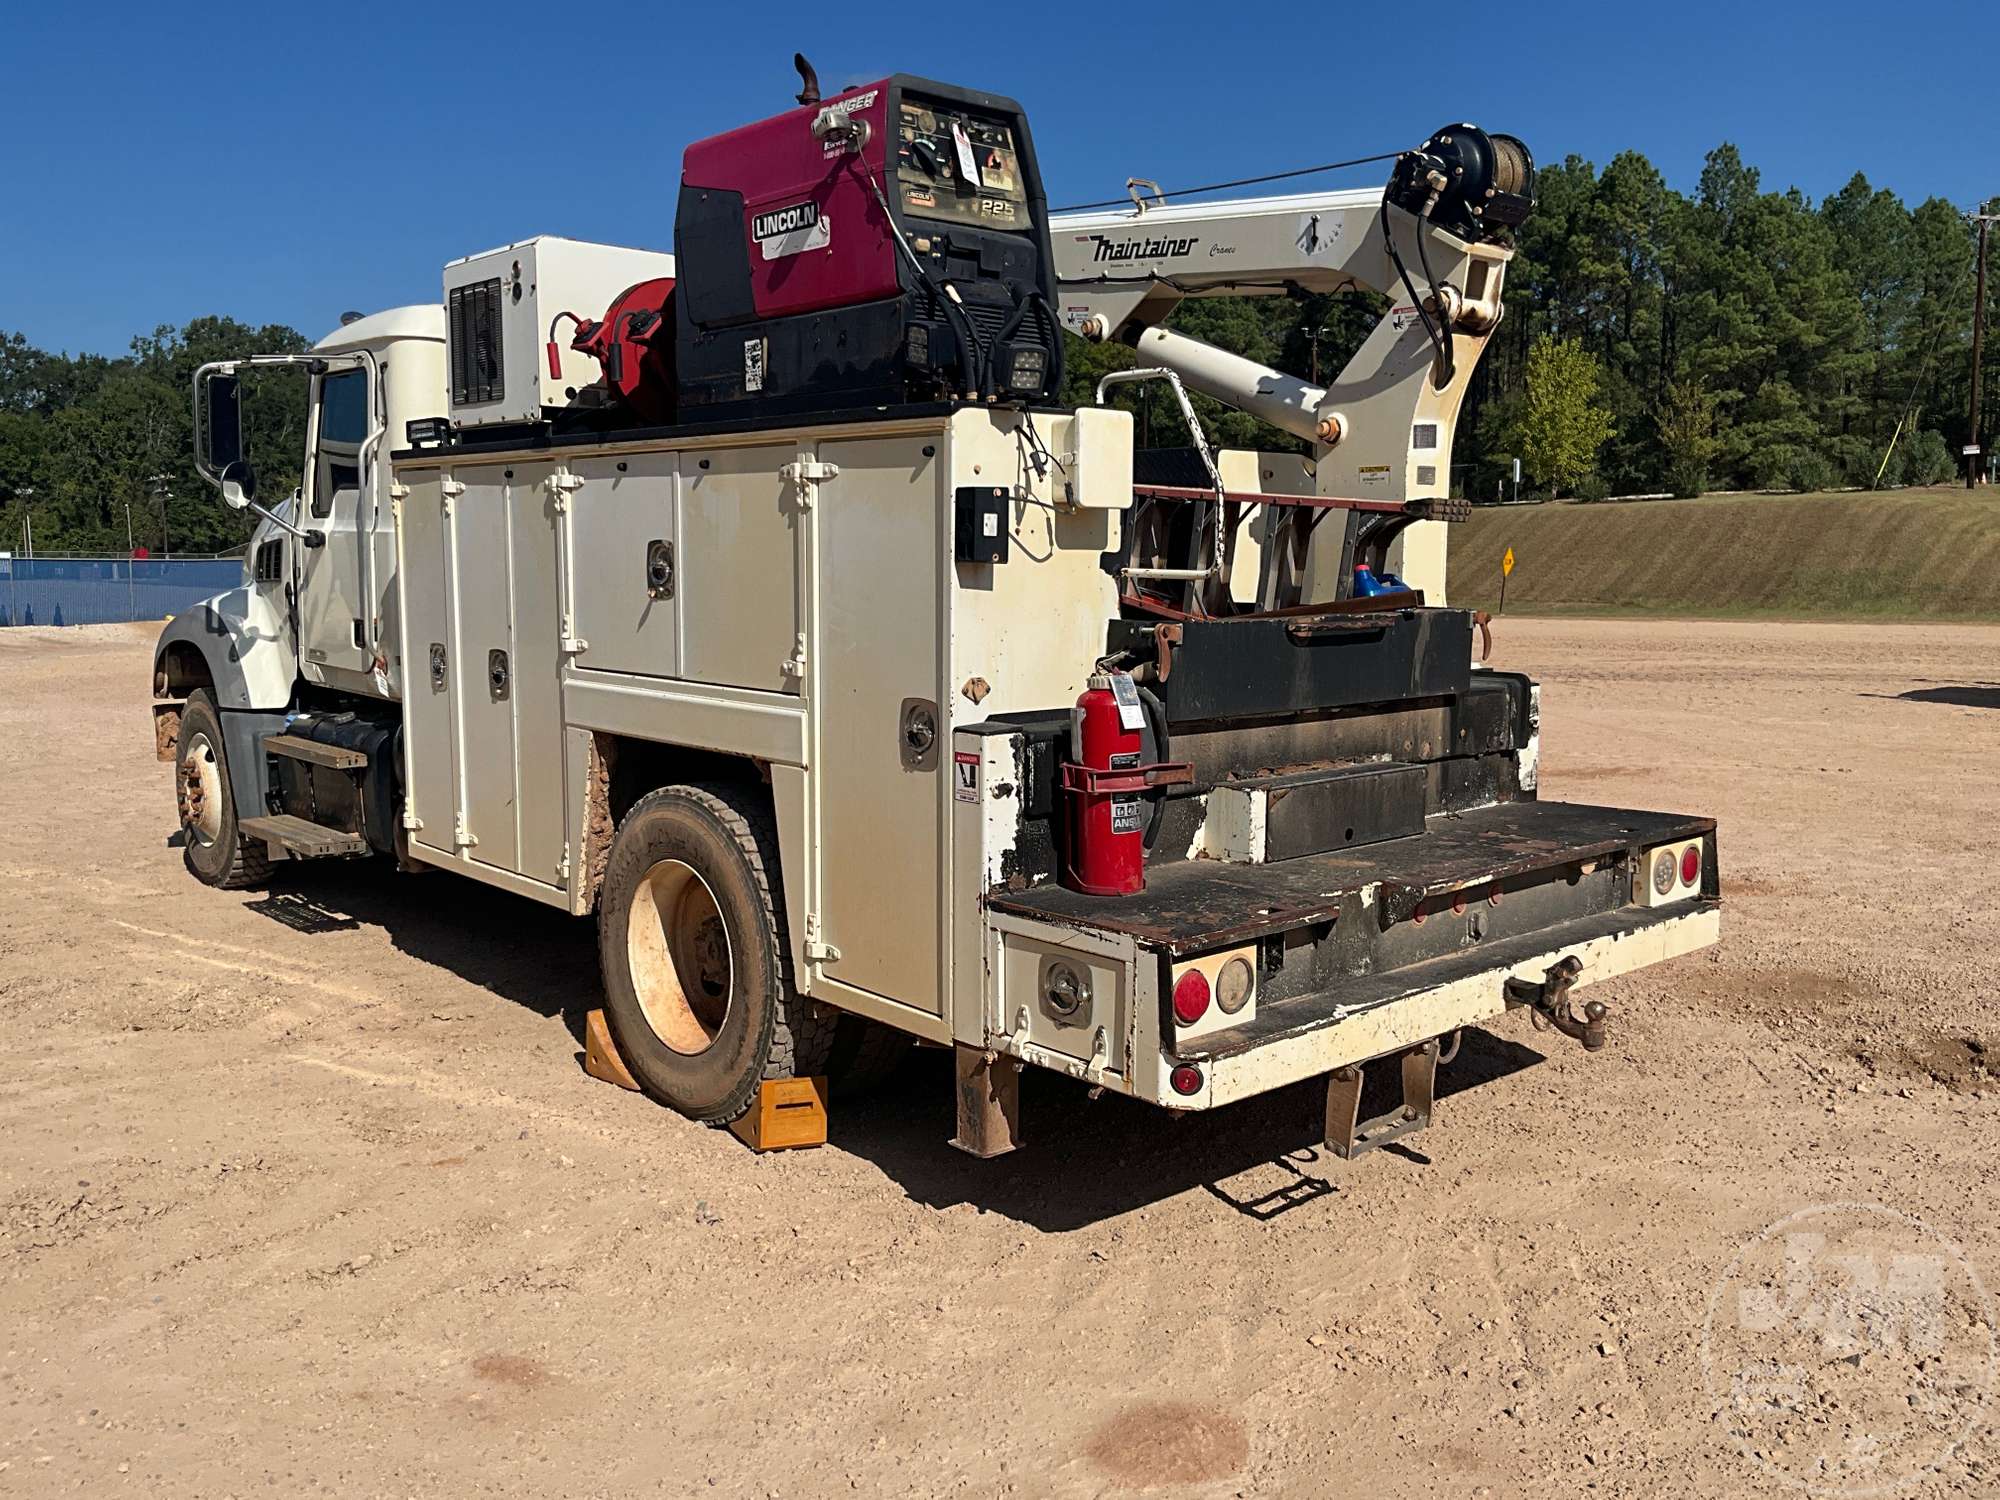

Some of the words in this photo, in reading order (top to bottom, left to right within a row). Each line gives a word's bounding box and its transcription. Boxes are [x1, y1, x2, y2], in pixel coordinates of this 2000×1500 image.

[982, 199, 1014, 216] 225
[756, 205, 815, 237] LINCOLN
[1089, 234, 1199, 262] Maintainer
[1114, 814, 1142, 828] ANSU
